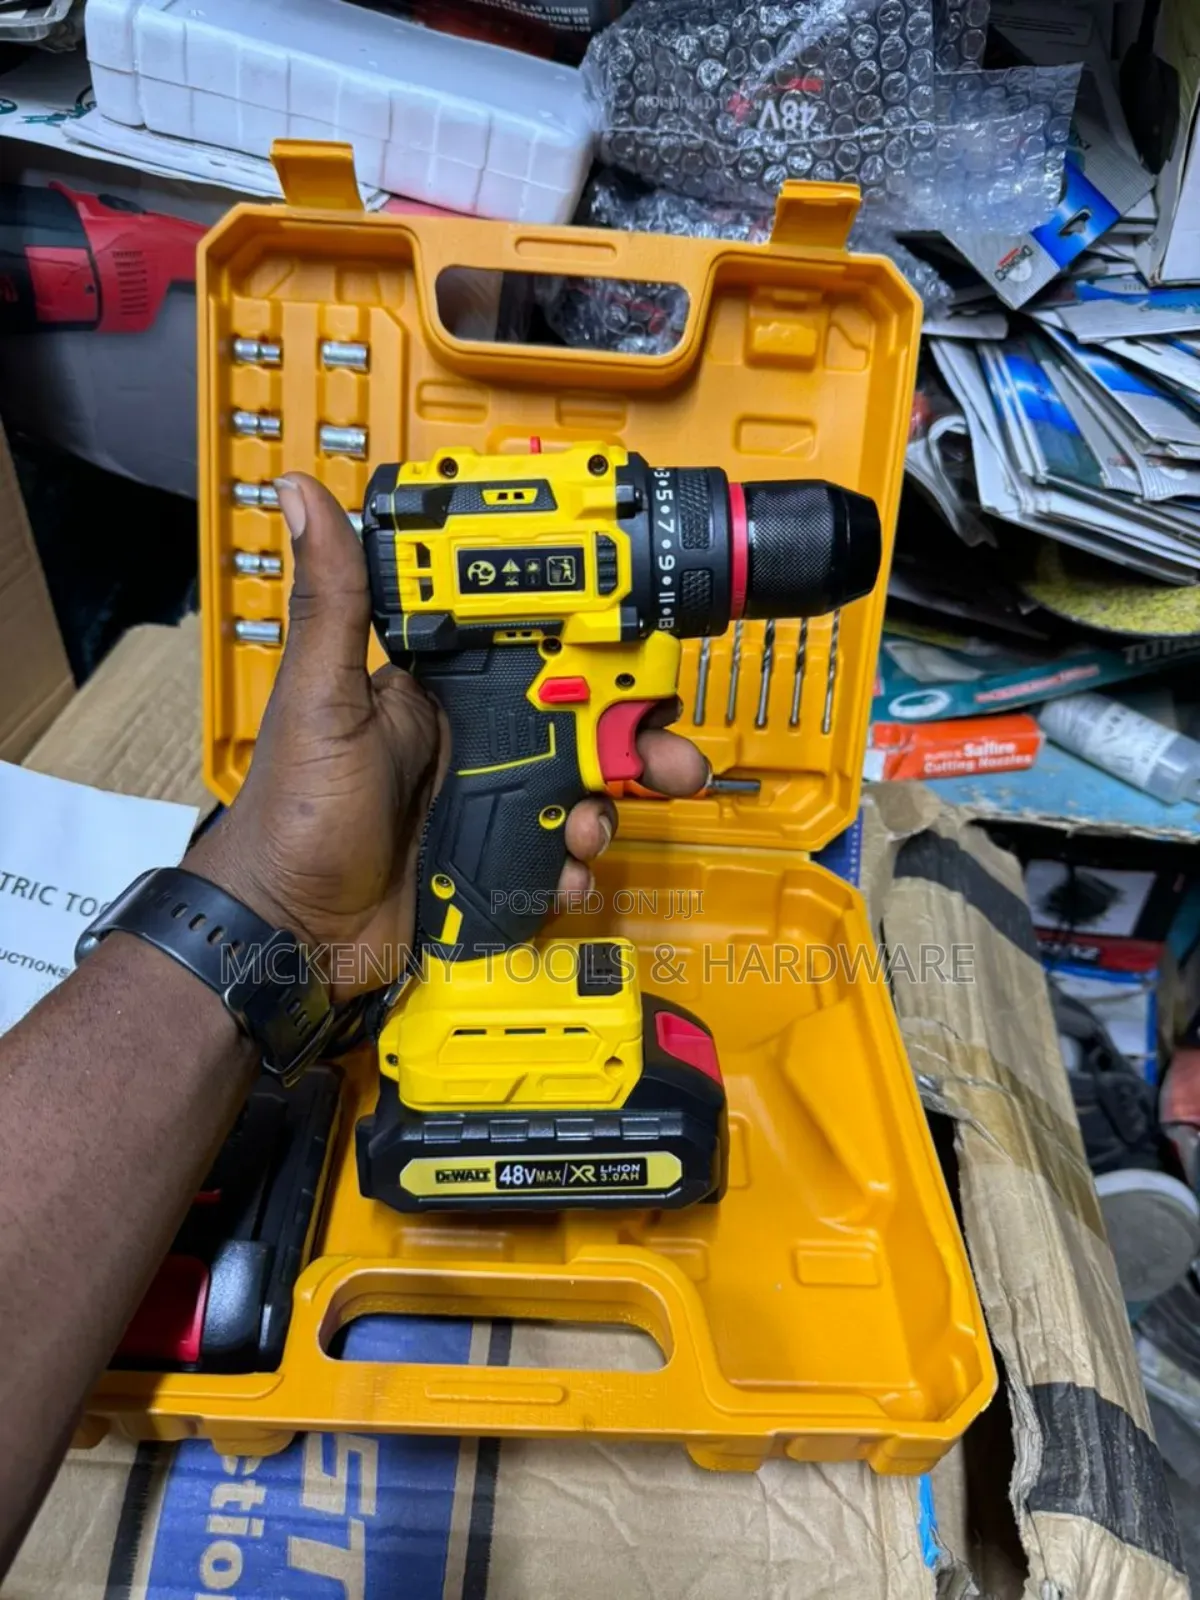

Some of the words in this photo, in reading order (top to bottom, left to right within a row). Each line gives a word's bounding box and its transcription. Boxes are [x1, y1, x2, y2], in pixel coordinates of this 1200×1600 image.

[758, 98, 817, 130] 48V
[656, 489, 673, 501] 5
[657, 519, 675, 533] 7
[658, 554, 675, 570] 9
[0, 870, 58, 906] TRIC
[600, 1164, 640, 1173] LI-ION
[600, 1172, 639, 1182] 3.0AH
[194, 1455, 267, 1600] tio
